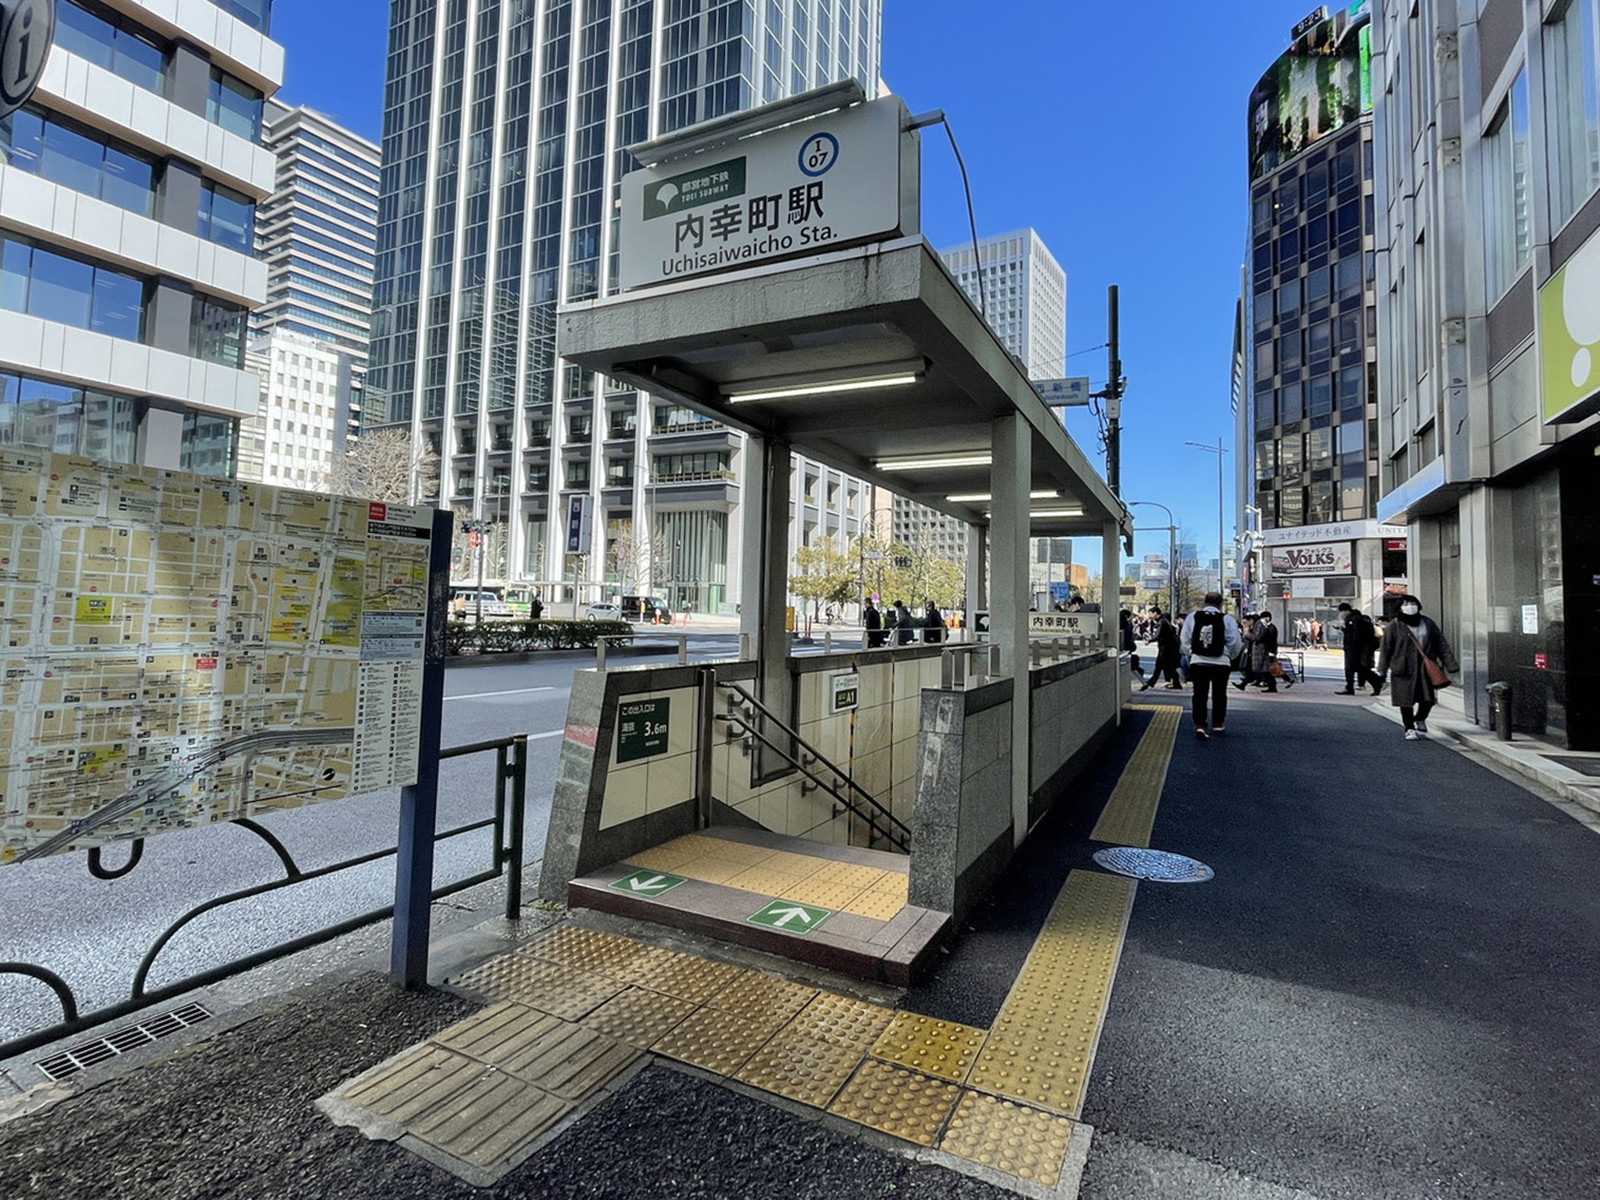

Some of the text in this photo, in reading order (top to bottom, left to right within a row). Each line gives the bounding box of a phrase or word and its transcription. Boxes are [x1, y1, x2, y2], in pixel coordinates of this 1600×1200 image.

[815, 140, 822, 152] I
[808, 153, 828, 169] 07
[699, 184, 729, 198] SUBWAY
[674, 181, 825, 253] 内幸町駅
[662, 224, 838, 276] Uchisaiwaicho Sta.
[1278, 526, 1352, 541] ユナイテッド不動産
[1286, 549, 1334, 569] VOLKS
[1033, 616, 1079, 628] 内幸町駅
[621, 704, 656, 716] この出入口は
[644, 721, 667, 736] 3.6m
